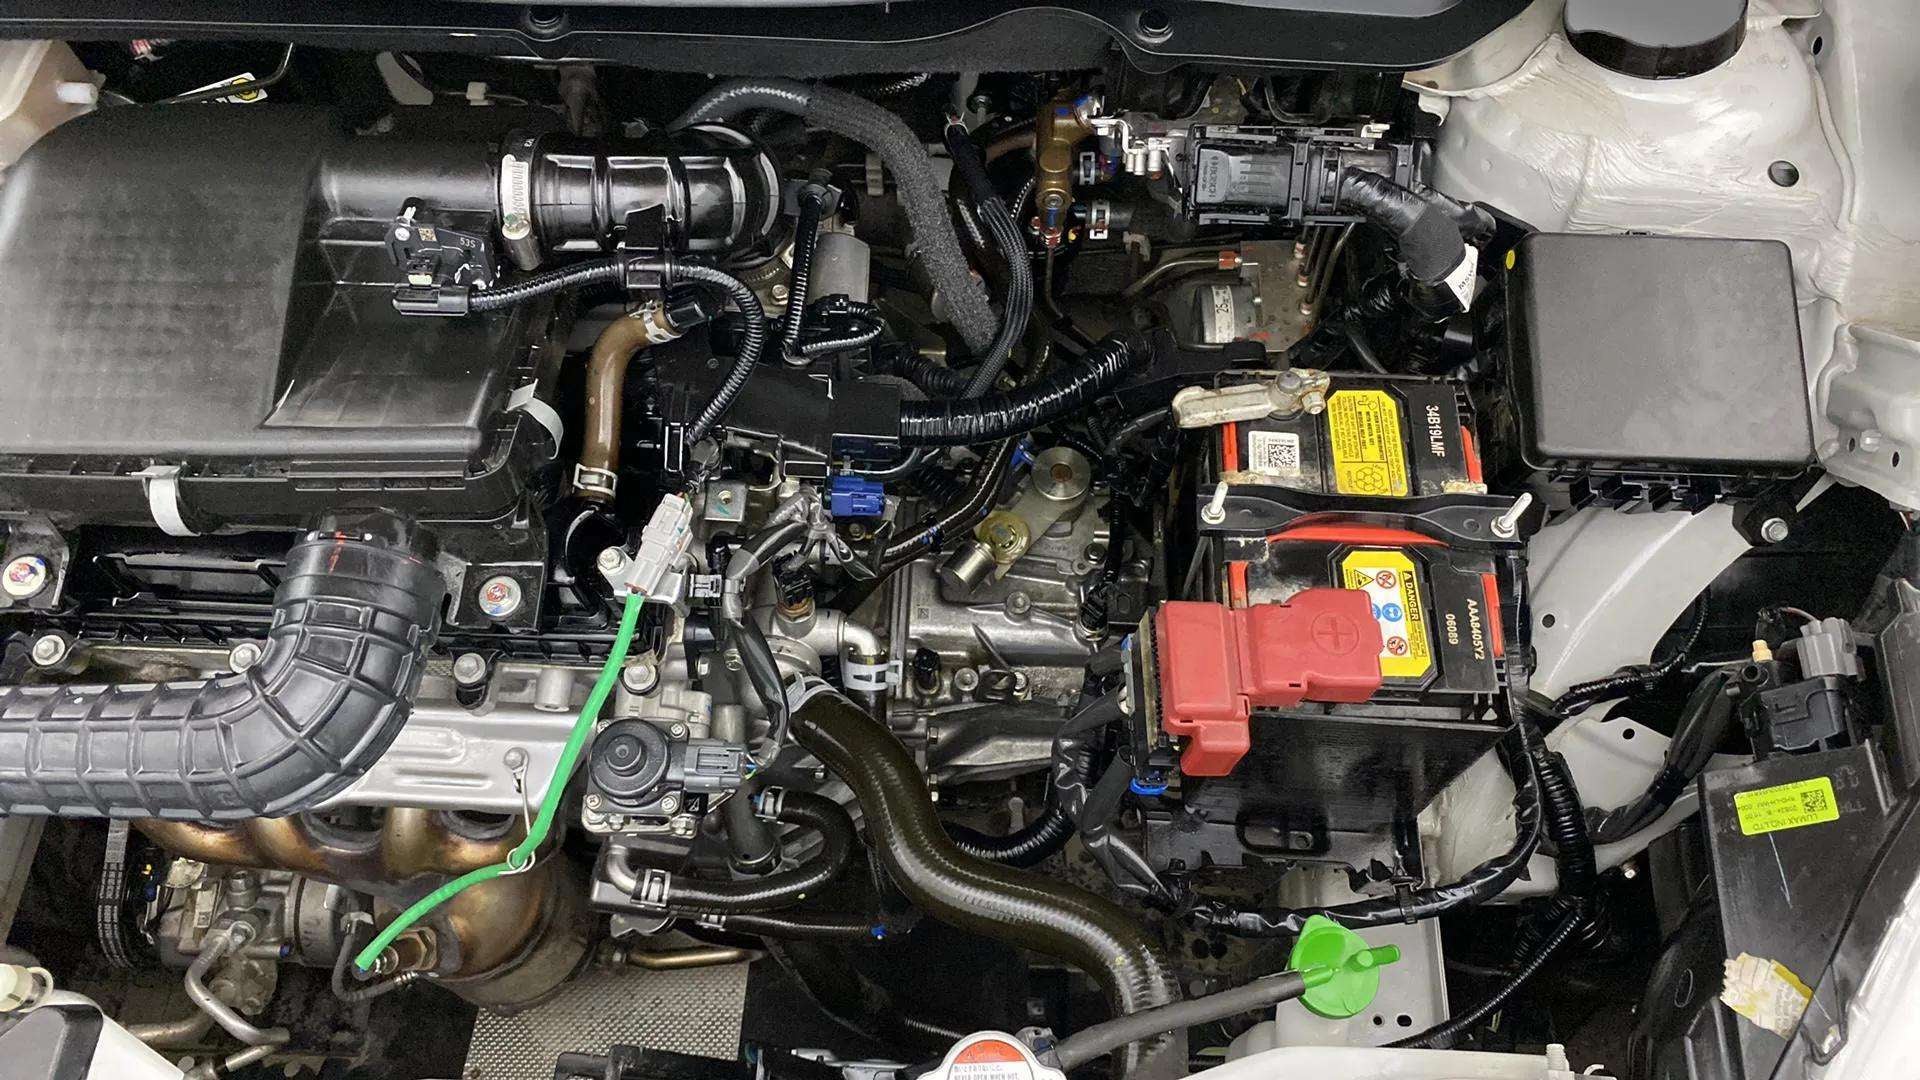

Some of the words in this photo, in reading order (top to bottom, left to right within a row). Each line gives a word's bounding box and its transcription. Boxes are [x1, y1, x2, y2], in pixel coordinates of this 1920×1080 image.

[459, 237, 476, 249] 53S
[1426, 404, 1446, 458] 34B19LMF
[1405, 581, 1418, 621] DANGER
[1467, 598, 1485, 660] AAA8405Y2
